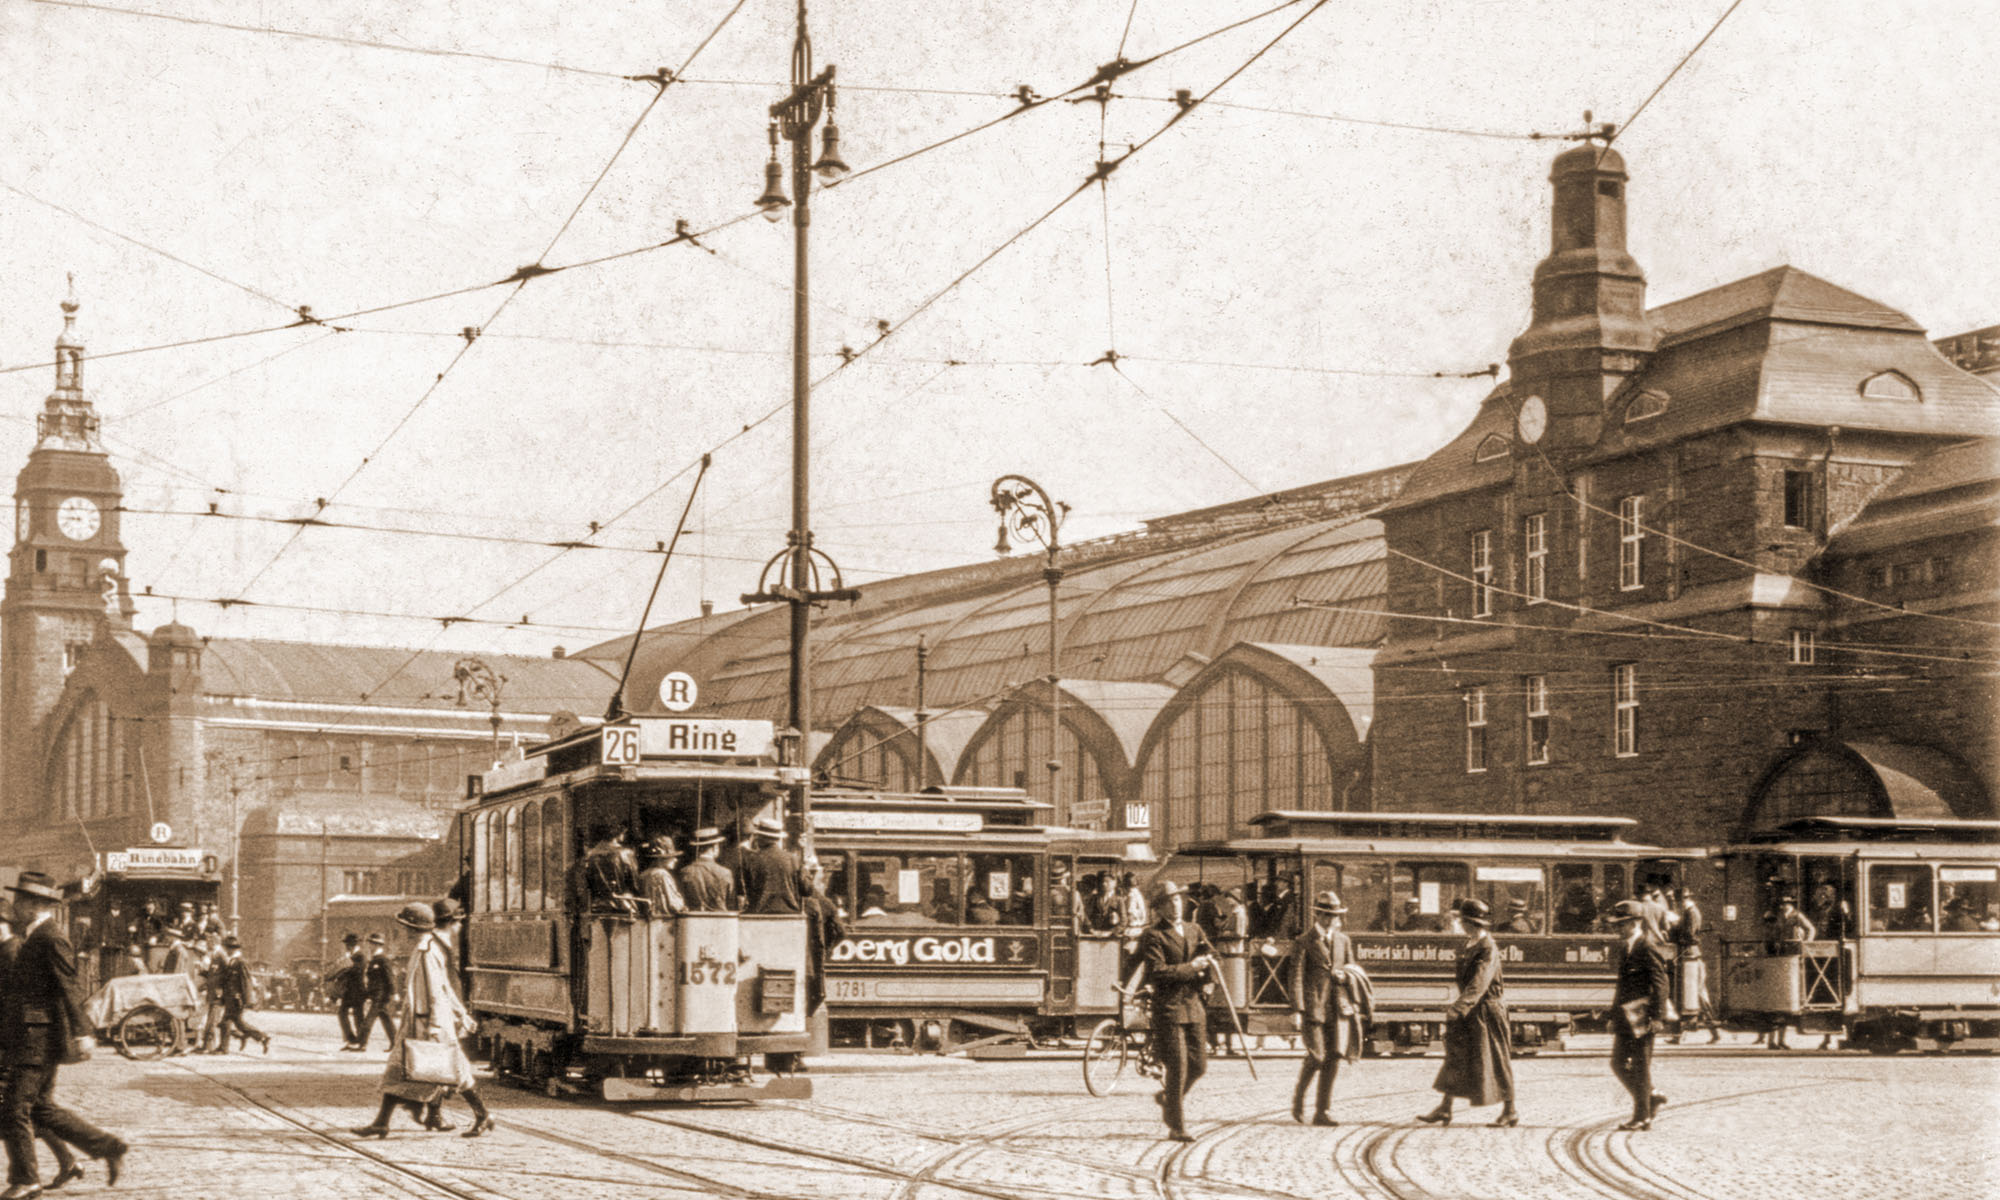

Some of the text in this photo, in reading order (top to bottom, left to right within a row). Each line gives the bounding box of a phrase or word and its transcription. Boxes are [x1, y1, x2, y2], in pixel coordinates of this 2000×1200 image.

[667, 678, 690, 703] R
[605, 730, 638, 762] 26
[669, 724, 737, 752] Ring
[830, 936, 996, 966] berg Gold
[836, 981, 865, 997] 1781
